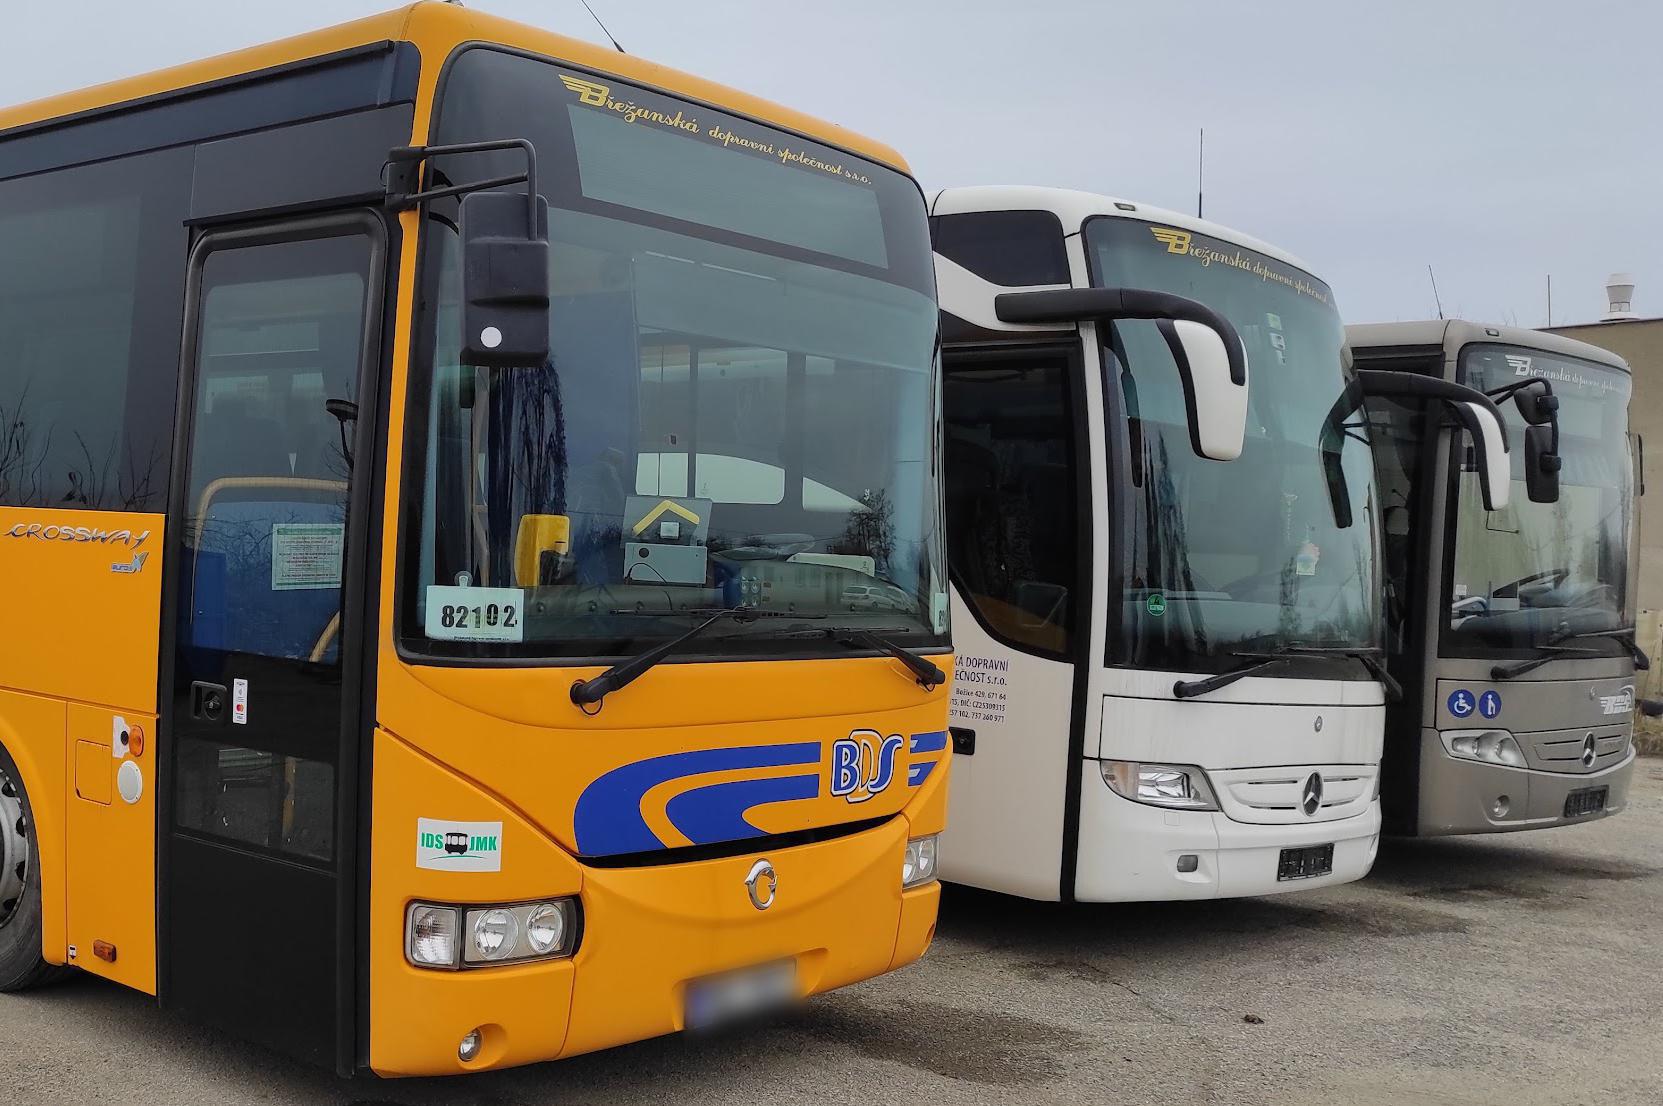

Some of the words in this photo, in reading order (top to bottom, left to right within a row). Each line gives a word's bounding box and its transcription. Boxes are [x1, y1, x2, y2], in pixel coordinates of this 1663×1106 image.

[5, 523, 150, 550] CROSSWAY
[441, 603, 517, 629] 82102
[966, 656, 1009, 672] DOPRAVNÍ
[987, 675, 1007, 686] s.r.o.
[831, 729, 904, 804] BDS
[421, 832, 444, 850] IDS
[469, 836, 497, 852] JMK
